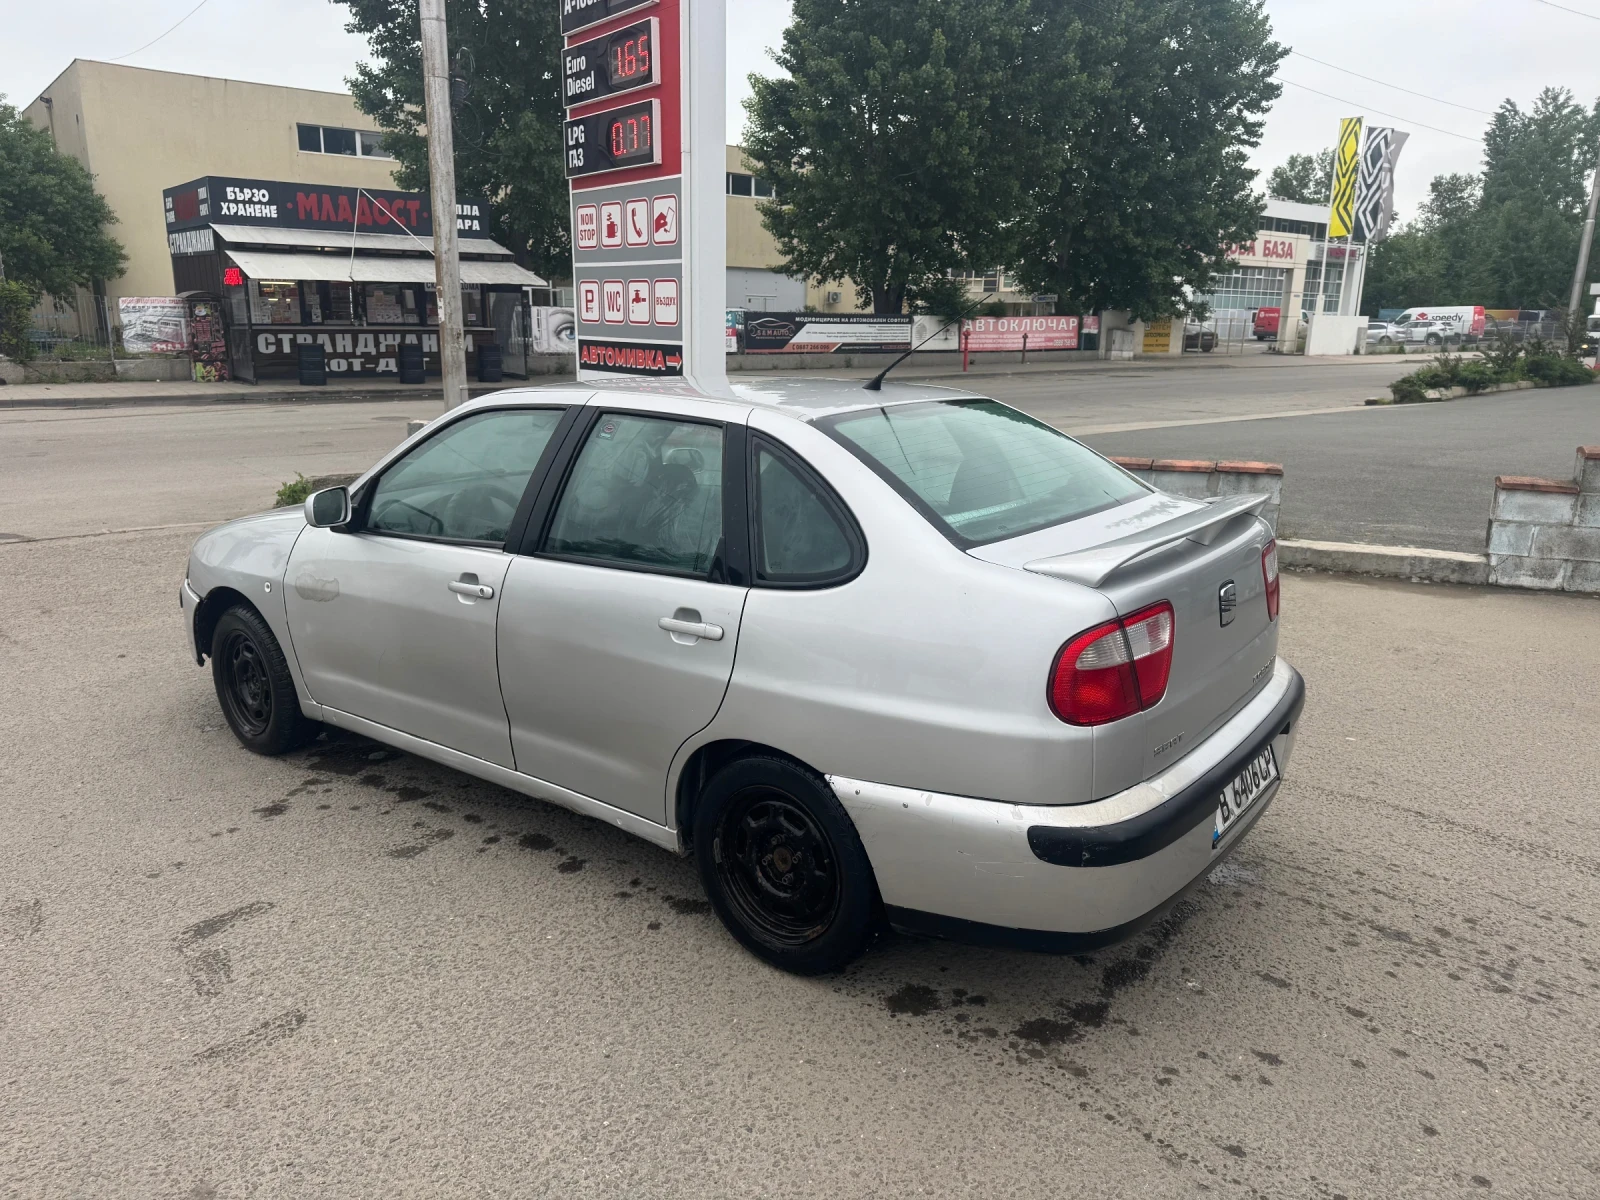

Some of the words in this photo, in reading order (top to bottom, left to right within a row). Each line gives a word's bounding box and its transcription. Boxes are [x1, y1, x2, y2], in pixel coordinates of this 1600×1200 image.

[566, 55, 586, 75] Euro
[617, 35, 649, 77] 1.65
[567, 70, 595, 97] Diesel
[568, 125, 585, 146] LPG
[612, 115, 650, 156] 0.77
[568, 148, 584, 168] ГАЗ
[226, 187, 269, 202] БЪРЗО
[220, 202, 278, 218] ХРАНЕНЕ
[296, 192, 421, 227] МЛАДОСТ
[455, 204, 480, 217] ПЛА
[580, 213, 594, 226] NON
[456, 218, 481, 231] АРА
[580, 228, 596, 241] STOP
[1262, 240, 1293, 260] БАЗА
[606, 290, 621, 312] WC
[655, 296, 677, 308] ВЪЗДУХ
[962, 318, 1078, 332] АВТОКЛЮЧАР
[1431, 312, 1463, 323] speedy
[257, 333, 474, 356] СТРАНДЖАНИ
[325, 357, 430, 373] ОТ-ДГ
[580, 345, 666, 371] АВТОМИВКА
[1219, 790, 1230, 824] B
